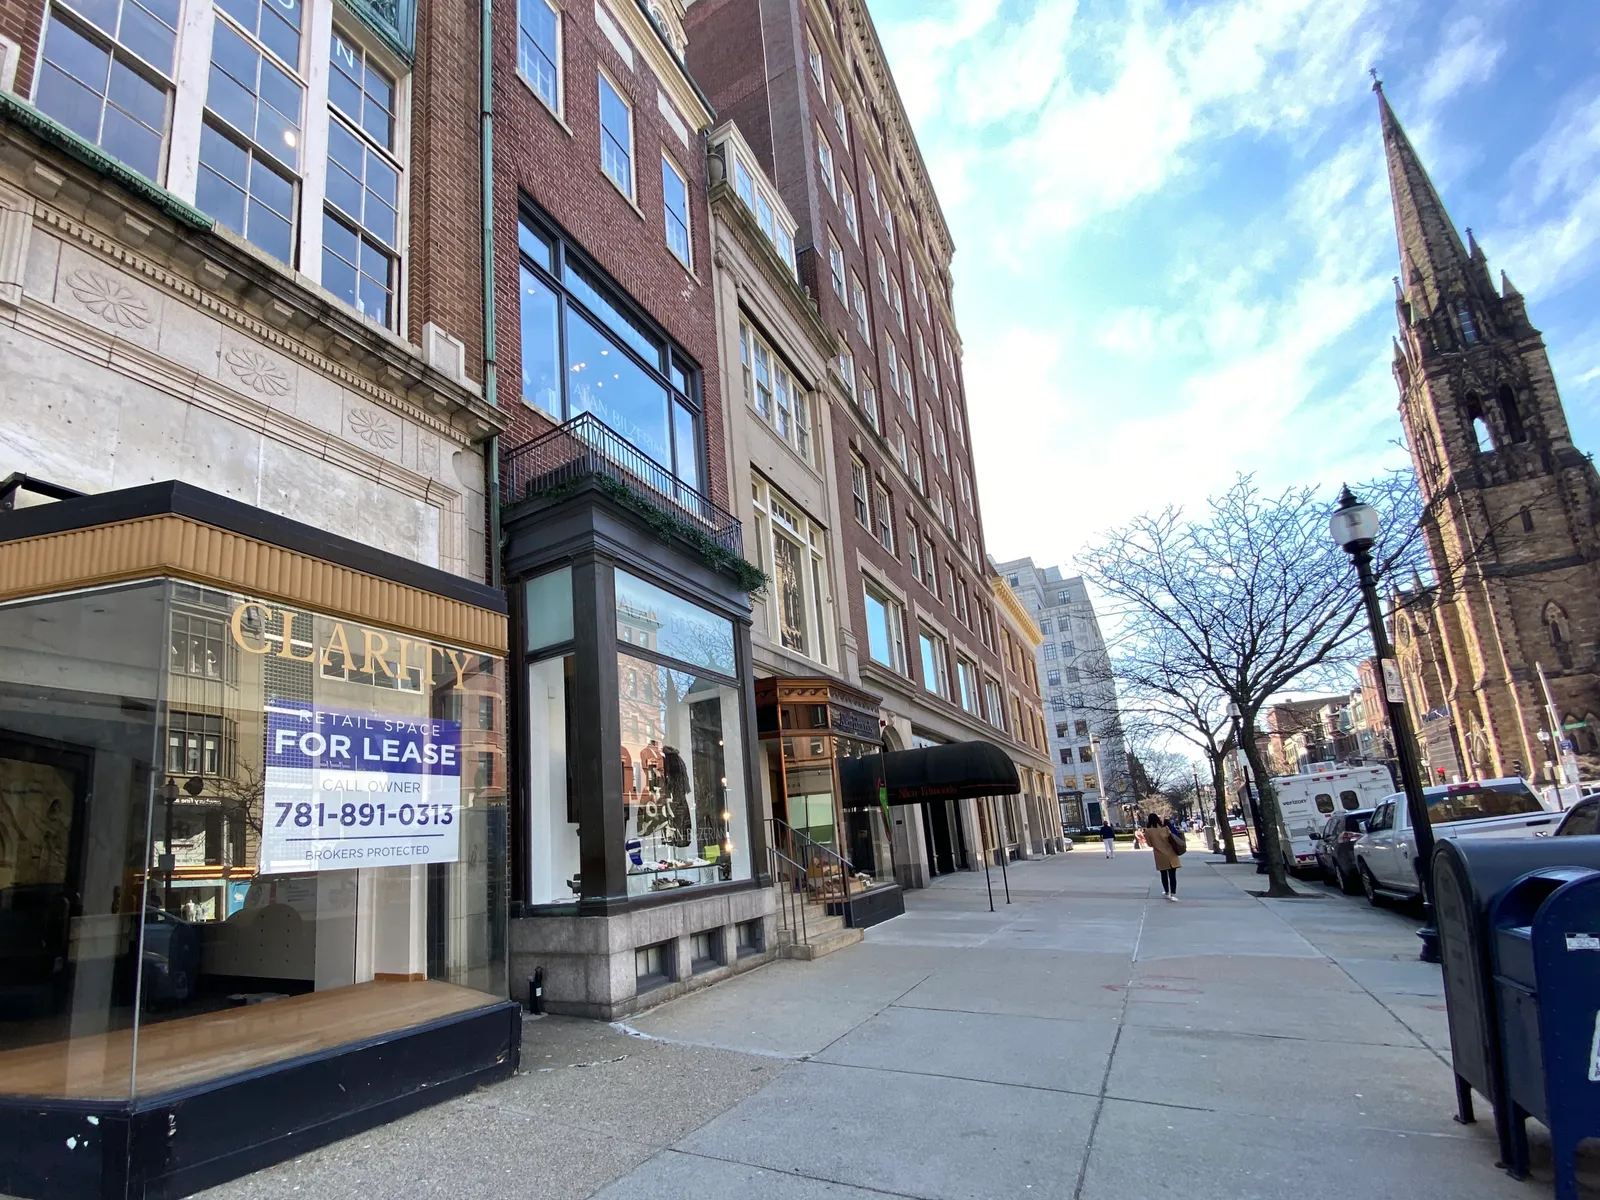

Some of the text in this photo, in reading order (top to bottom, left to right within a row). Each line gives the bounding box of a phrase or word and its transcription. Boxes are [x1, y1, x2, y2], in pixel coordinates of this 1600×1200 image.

[231, 602, 475, 691] CLARITY
[299, 709, 441, 737] RETAIL SPACE
[274, 729, 456, 766] FOR LEASE
[322, 779, 421, 794] CALL OWNER
[274, 801, 454, 828] 781-891-0313
[305, 845, 430, 861] BROKERS PROTECTED
